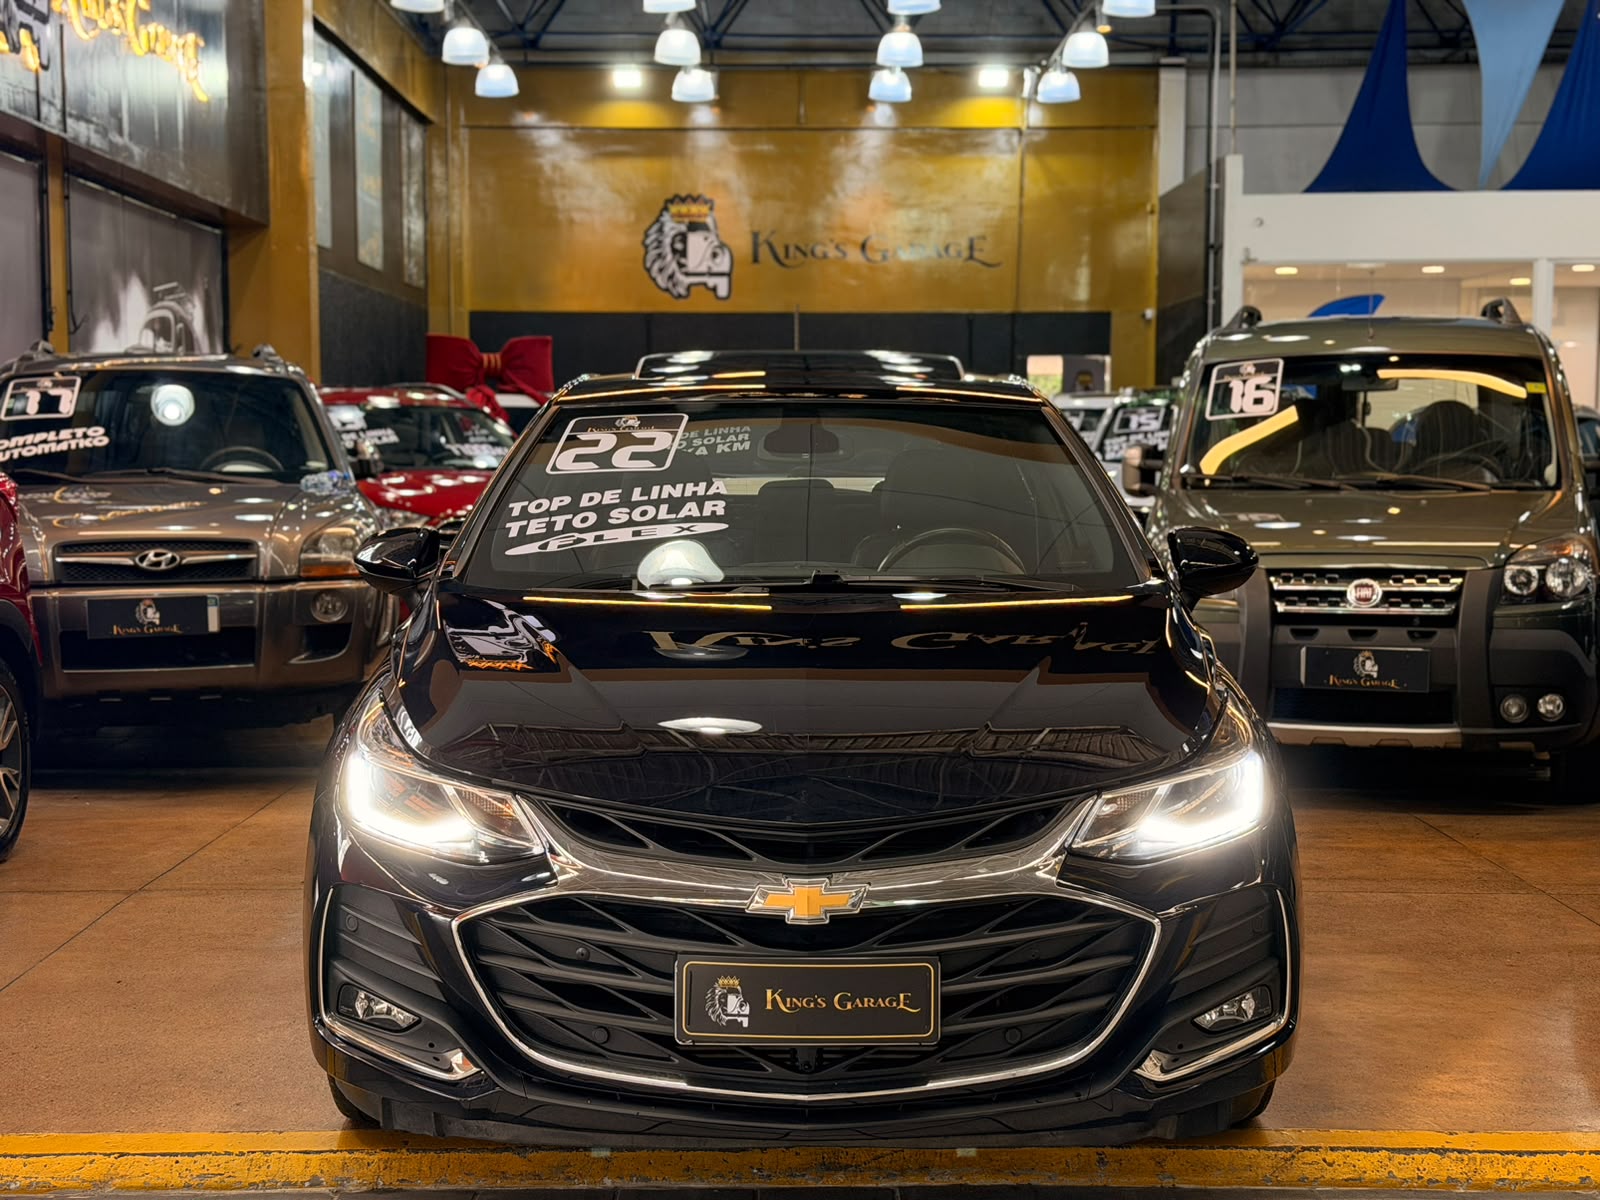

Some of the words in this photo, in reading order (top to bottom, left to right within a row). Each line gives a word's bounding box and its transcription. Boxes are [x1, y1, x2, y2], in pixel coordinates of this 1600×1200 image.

[1228, 376, 1275, 413] 16
[0, 426, 105, 450] OMPLETO
[0, 436, 110, 462] UTOMATICO
[555, 432, 673, 470] 22
[692, 434, 750, 447] SOLAR
[716, 441, 751, 453] KM
[508, 495, 572, 517] TOP
[579, 489, 622, 508] DE
[631, 480, 728, 501] LINHA
[505, 511, 598, 538] TETO
[607, 500, 727, 525] SOLAR
[537, 524, 704, 552] FLEX
[765, 988, 827, 1013] KING'S
[833, 991, 921, 1013] GARAGE
